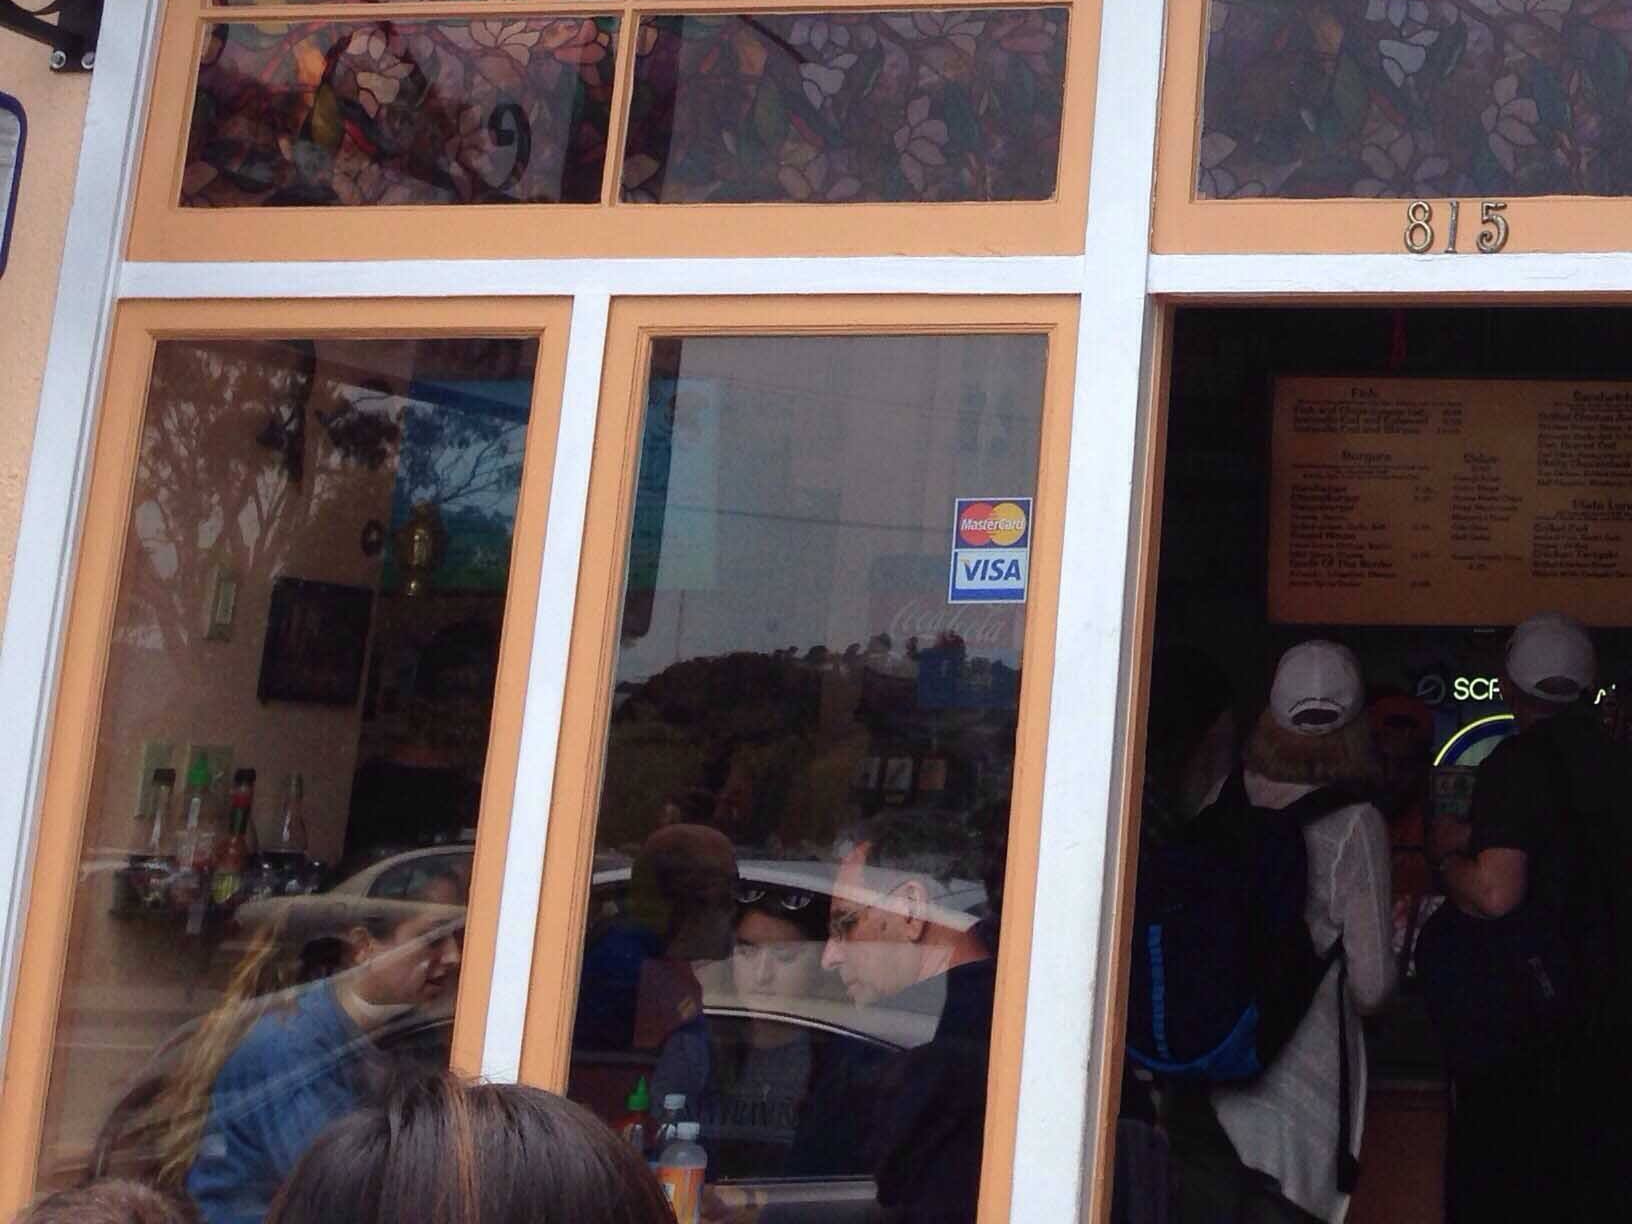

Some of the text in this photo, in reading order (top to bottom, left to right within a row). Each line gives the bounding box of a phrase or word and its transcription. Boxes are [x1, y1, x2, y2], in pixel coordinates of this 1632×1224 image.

[1404, 200, 1509, 253] 815
[961, 518, 1025, 531] MasterCard
[961, 558, 1021, 581] VISA
